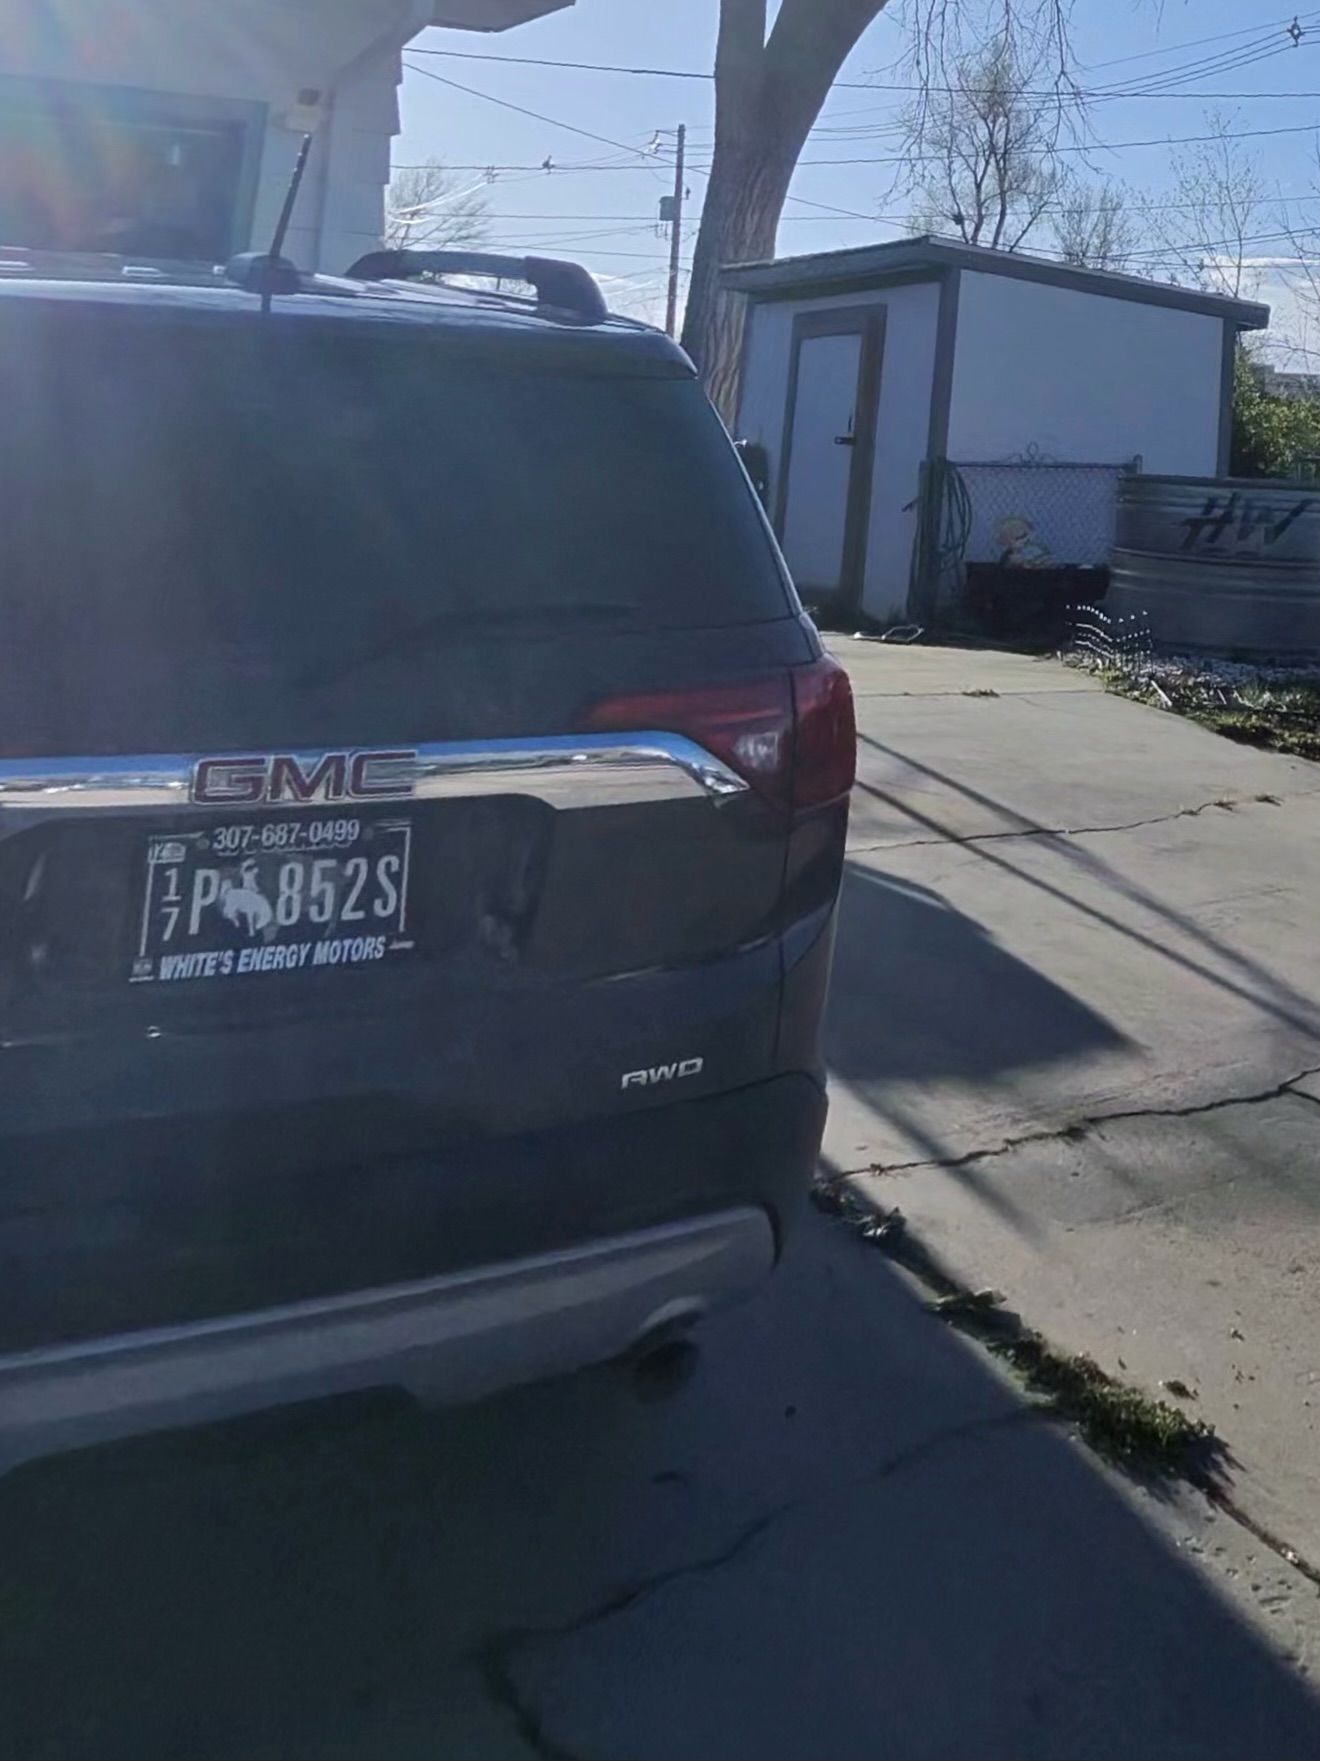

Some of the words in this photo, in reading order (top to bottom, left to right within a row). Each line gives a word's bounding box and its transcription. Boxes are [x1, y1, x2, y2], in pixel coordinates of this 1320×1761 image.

[191, 750, 418, 805] GMC
[213, 819, 360, 849] 307-687-0499
[159, 949, 234, 980] WHITE'S
[237, 942, 311, 973] ENERGY
[312, 936, 386, 965] MOTORS
[621, 1057, 704, 1089] AWD
